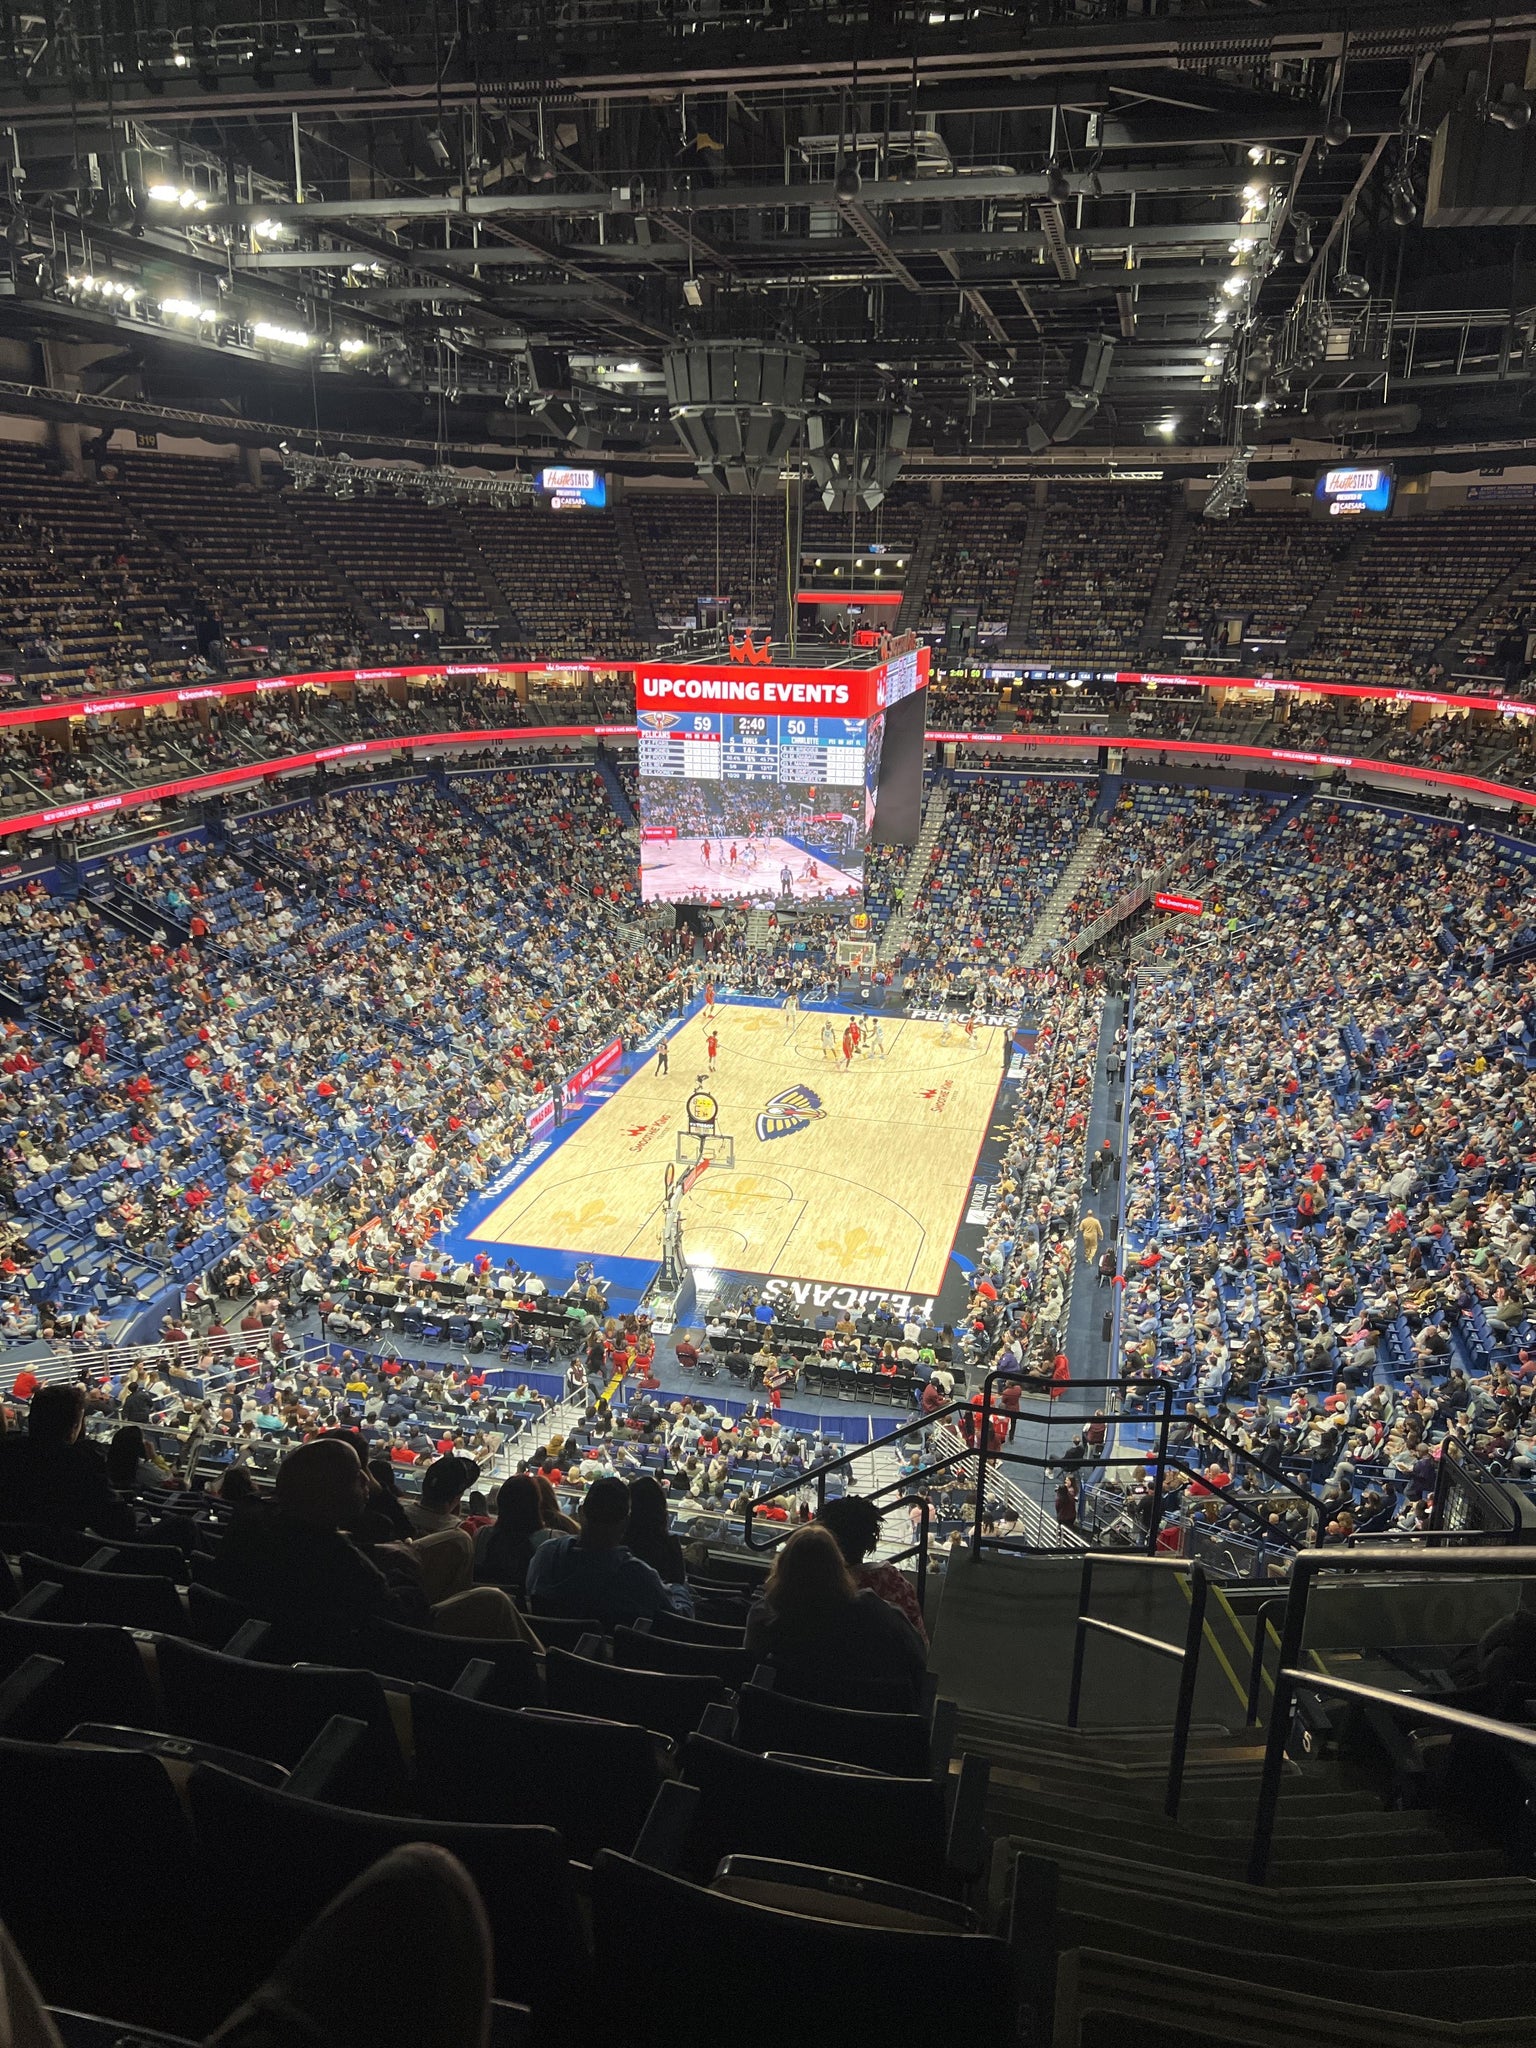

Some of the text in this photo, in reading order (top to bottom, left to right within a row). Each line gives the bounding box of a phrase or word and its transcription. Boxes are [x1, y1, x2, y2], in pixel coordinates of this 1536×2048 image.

[138, 434, 156, 447] 319
[561, 497, 586, 506] CAESARS
[1340, 502, 1366, 510] CAESARS
[643, 678, 849, 704] UPCOMING EVENTS
[693, 716, 712, 731] 59
[738, 717, 766, 730] 2:40
[787, 720, 806, 735] 50
[641, 730, 671, 739] PELICANS
[854, 913, 867, 929] 19
[861, 989, 870, 998] G
[486, 1141, 553, 1196] Ochsner Health
[1302, 1730, 1312, 1753] 5
